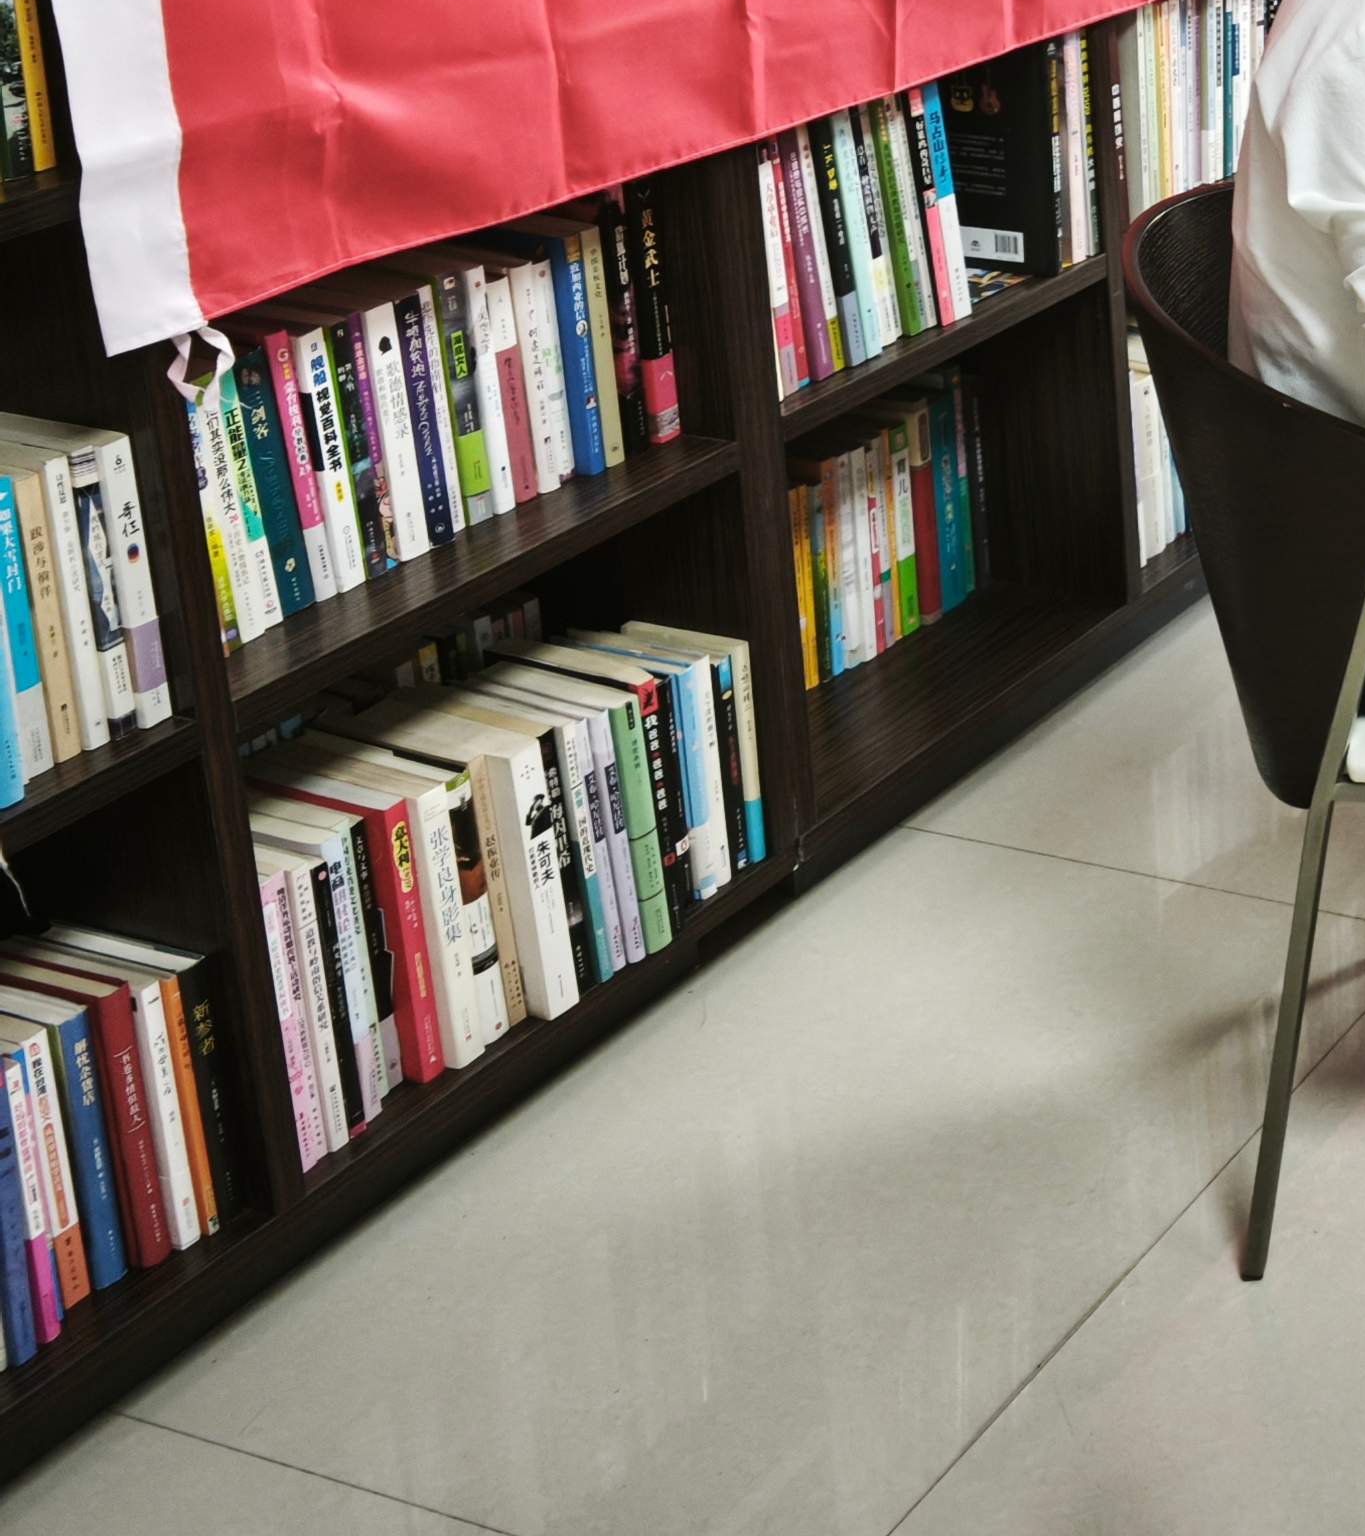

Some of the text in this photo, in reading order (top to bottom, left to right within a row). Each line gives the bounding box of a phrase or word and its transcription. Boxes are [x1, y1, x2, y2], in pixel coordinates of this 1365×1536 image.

[430, 824, 463, 947] 张学良身影集
